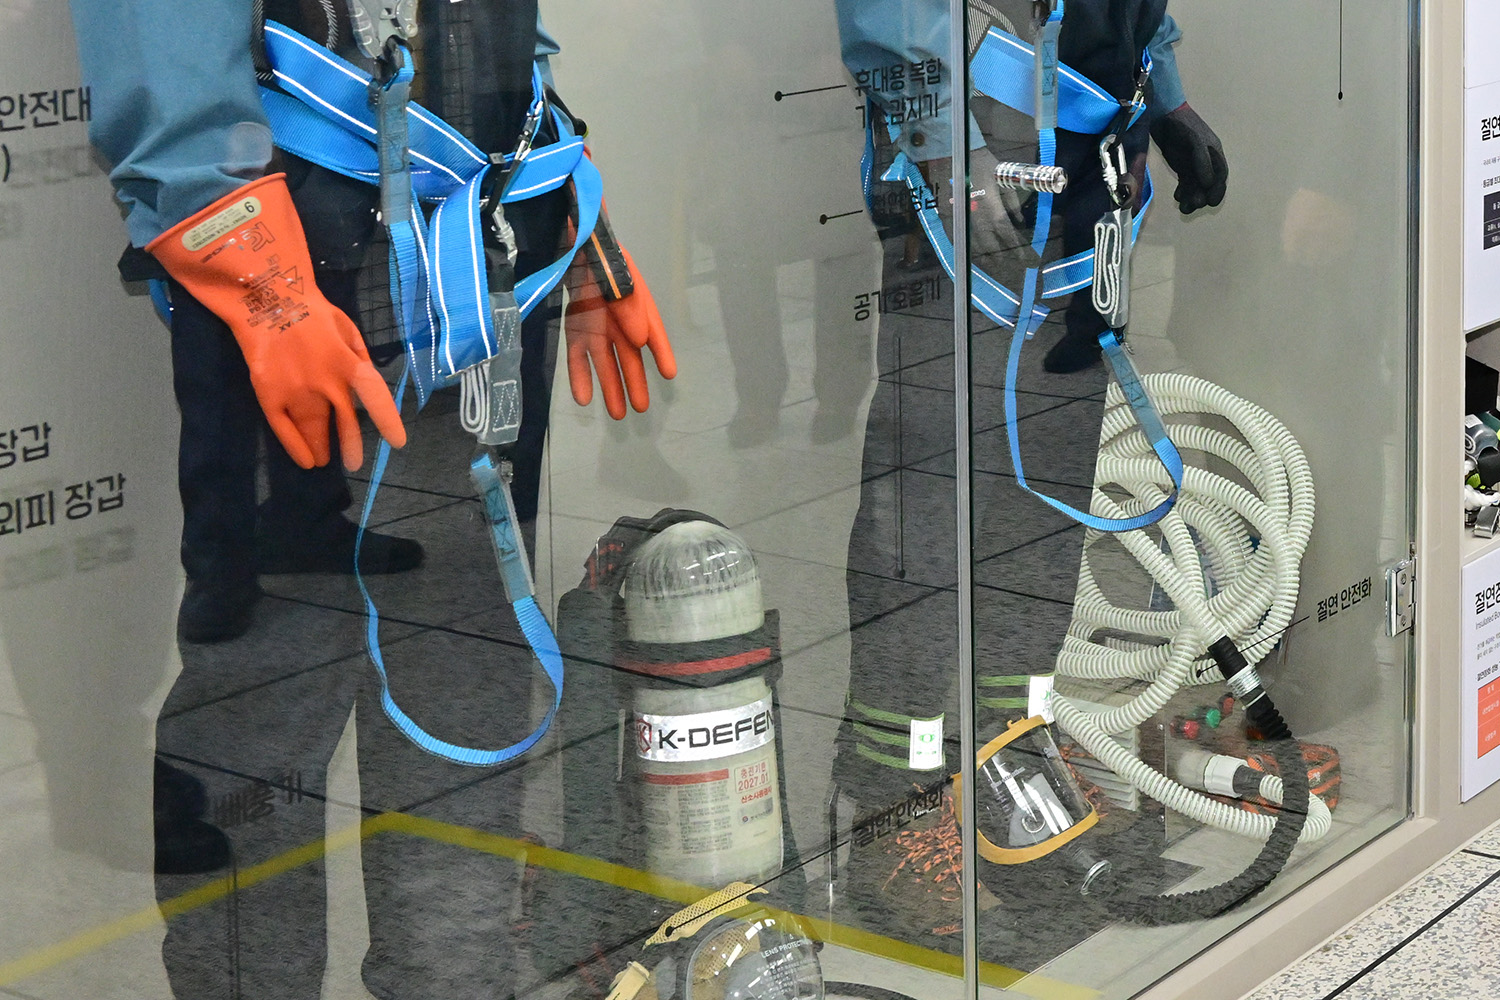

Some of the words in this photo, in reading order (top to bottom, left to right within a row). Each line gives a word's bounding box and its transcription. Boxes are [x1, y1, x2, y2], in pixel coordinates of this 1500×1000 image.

[855, 64, 906, 97] 휴대용
[910, 58, 942, 89] 복합
[0, 86, 92, 131] 안전대
[0, 421, 51, 469] 장갑
[0, 491, 54, 535] 외피
[65, 473, 126, 520] 장갑
[1317, 594, 1339, 623] 절연
[1341, 576, 1372, 611] 안전화
[738, 773, 769, 792] 2027.01
[761, 947, 778, 959] LENS
